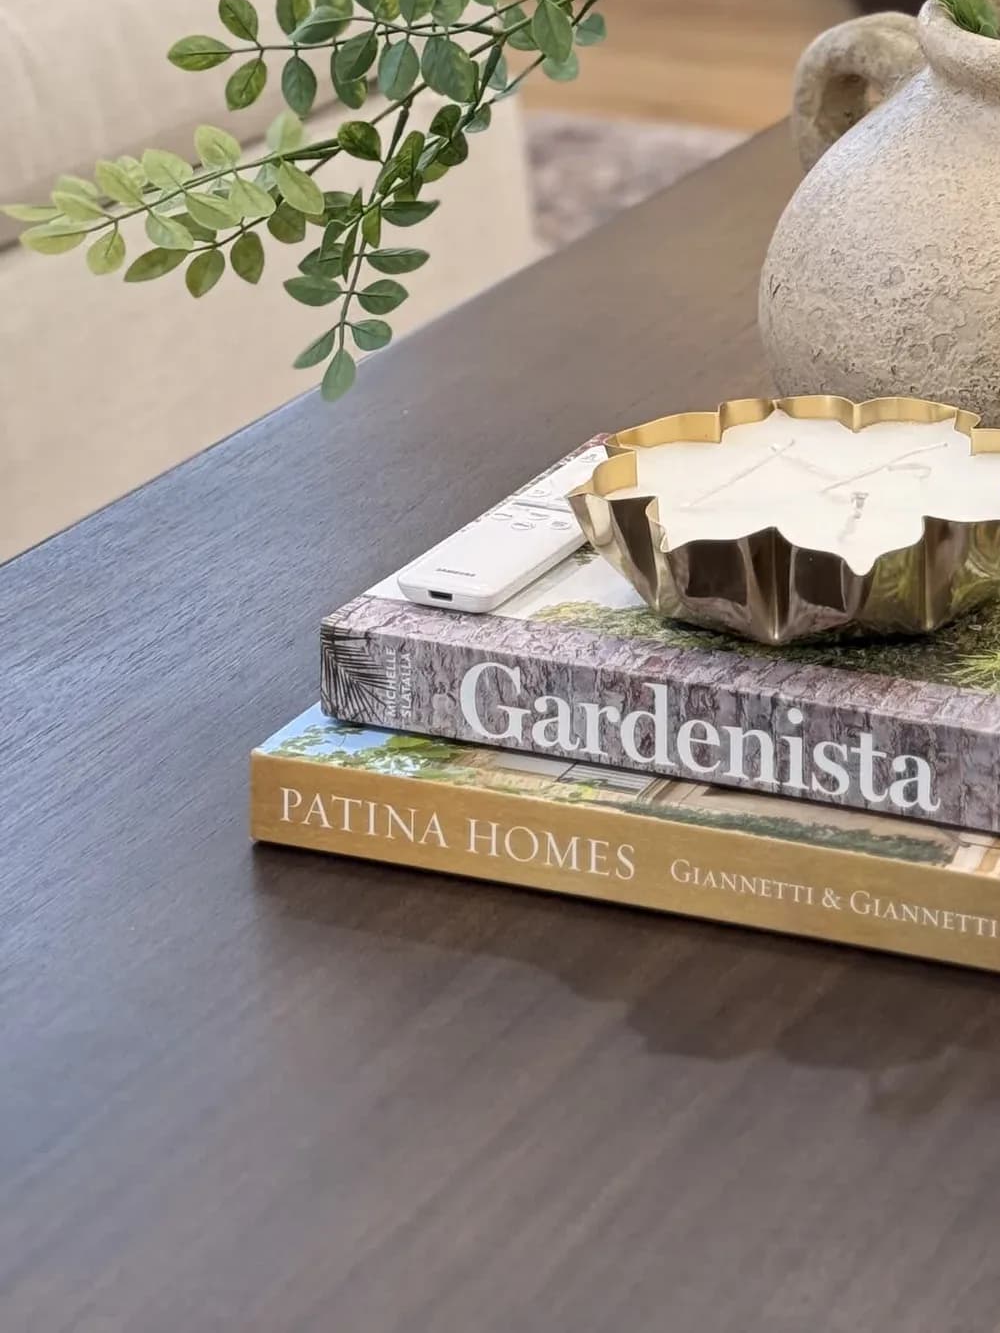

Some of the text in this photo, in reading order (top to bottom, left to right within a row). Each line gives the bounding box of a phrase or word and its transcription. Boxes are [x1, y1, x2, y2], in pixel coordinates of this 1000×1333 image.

[385, 647, 396, 718] MICHELLE
[401, 653, 412, 718] SLATALLA
[460, 662, 941, 812] Gardenista
[279, 787, 635, 881] PATINA HOMES
[822, 888, 841, 910] &
